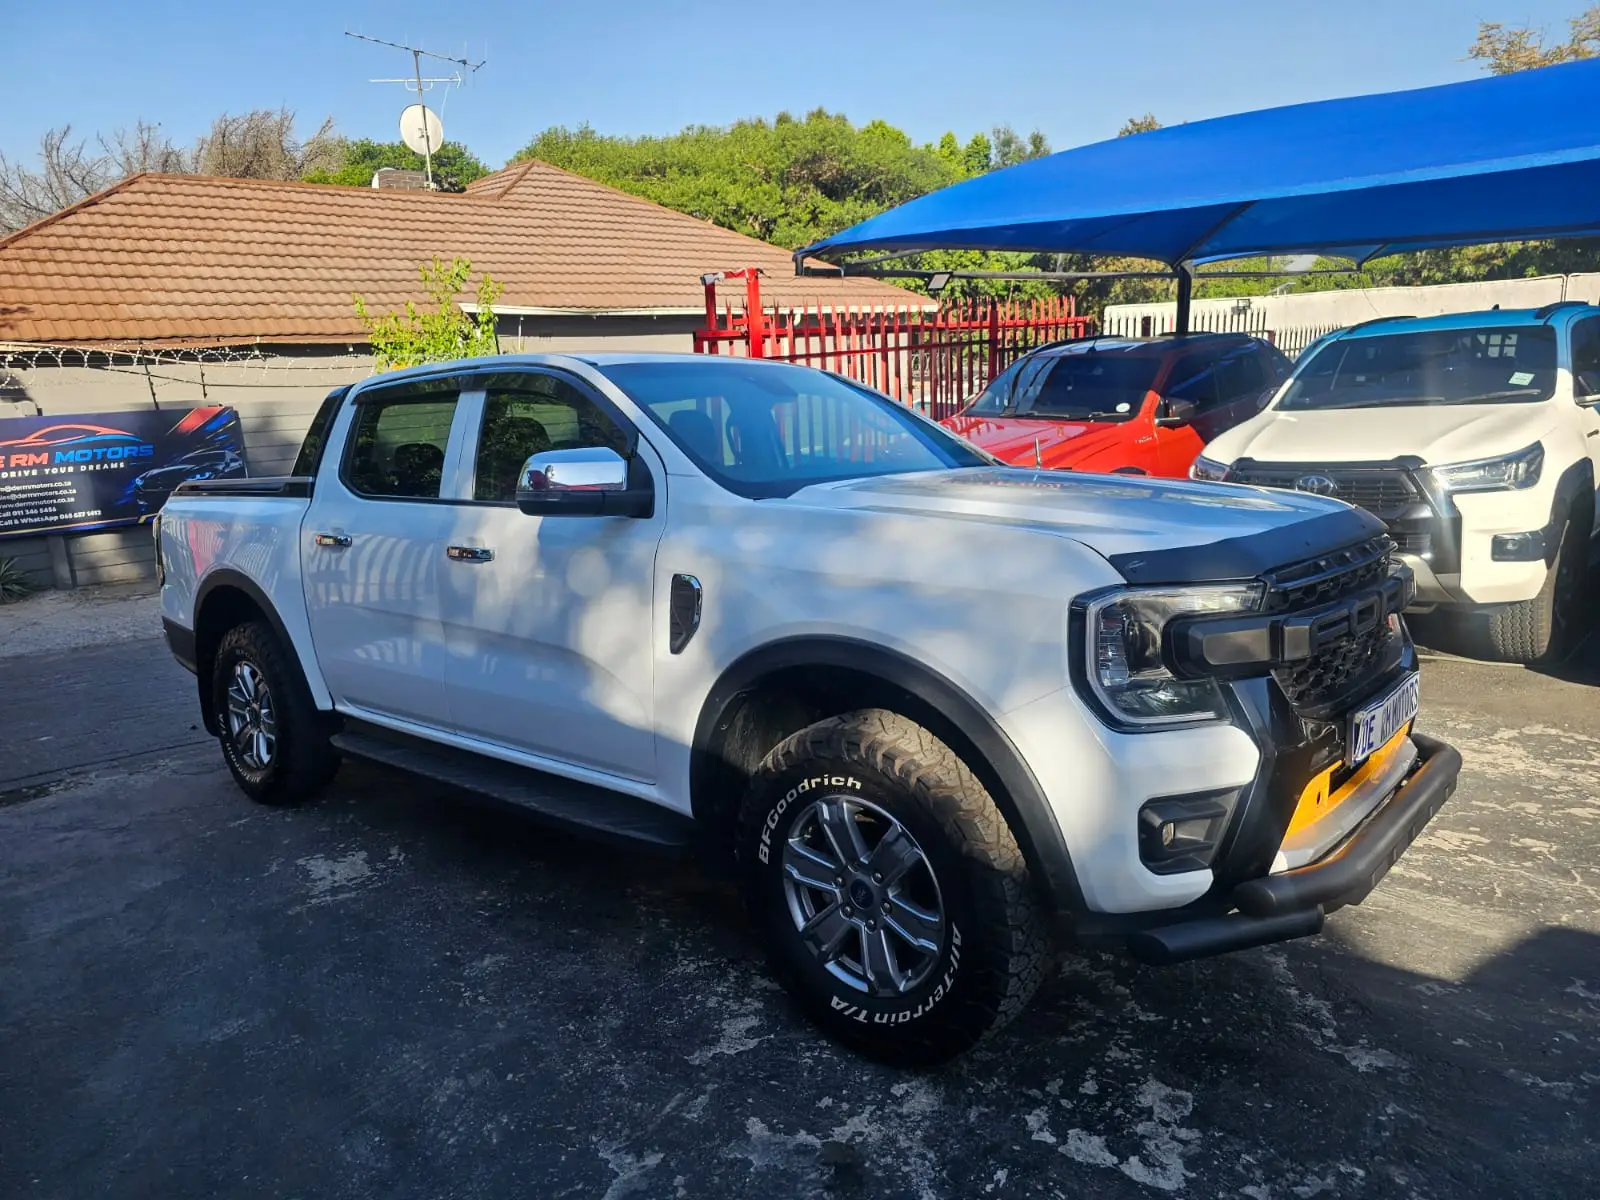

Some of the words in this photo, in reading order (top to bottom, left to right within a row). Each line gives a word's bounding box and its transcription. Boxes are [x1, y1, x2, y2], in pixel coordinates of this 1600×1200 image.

[9, 452, 48, 467] RM
[54, 445, 154, 464] MOTORS
[1, 469, 38, 479] DRIVE
[44, 465, 74, 475] YOUR
[80, 462, 125, 472] DREAMS
[20, 515, 59, 523] WhatsApp
[758, 774, 862, 865] BFGoodrich
[874, 921, 962, 1026] All-Terrain
[830, 995, 868, 1024] T/A
